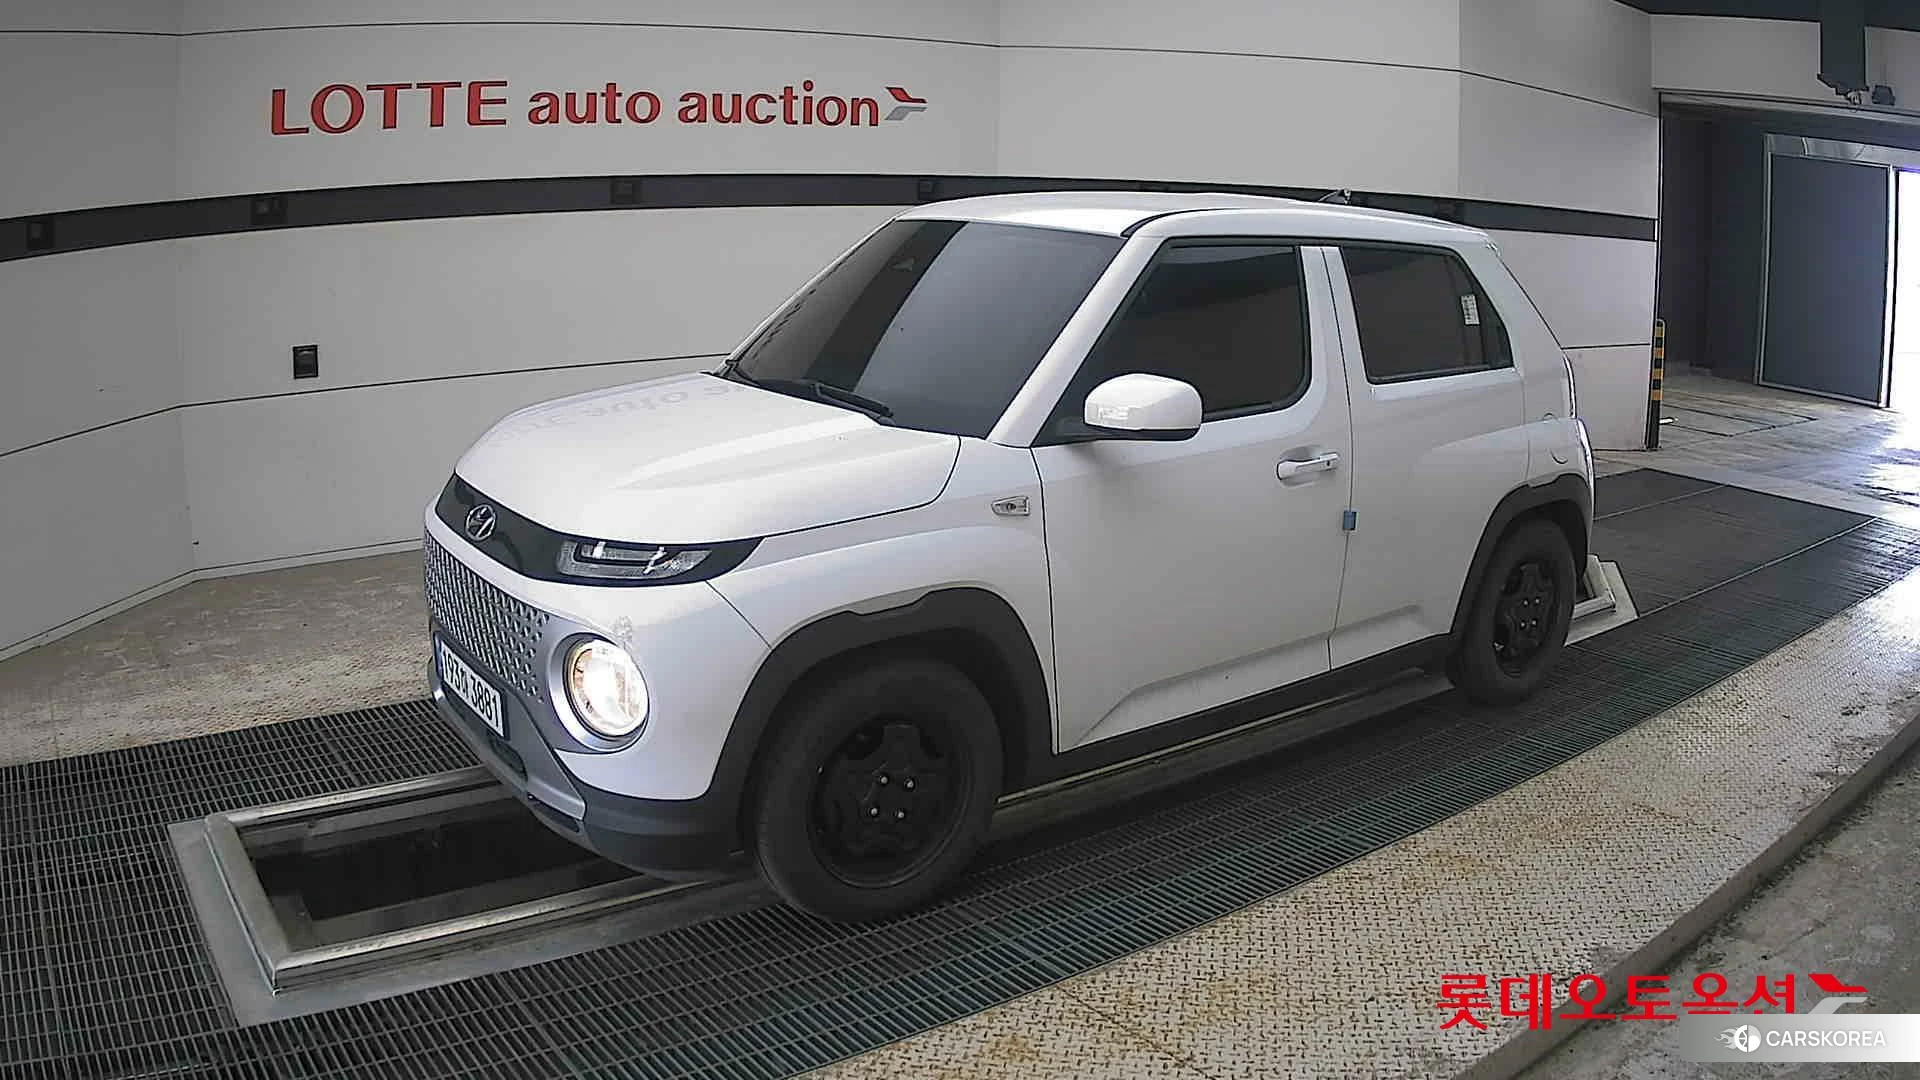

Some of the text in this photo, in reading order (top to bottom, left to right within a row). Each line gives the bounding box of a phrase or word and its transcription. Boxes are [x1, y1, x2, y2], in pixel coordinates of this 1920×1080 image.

[271, 80, 880, 136] LOTTE auto auction
[470, 673, 500, 729] 3881
